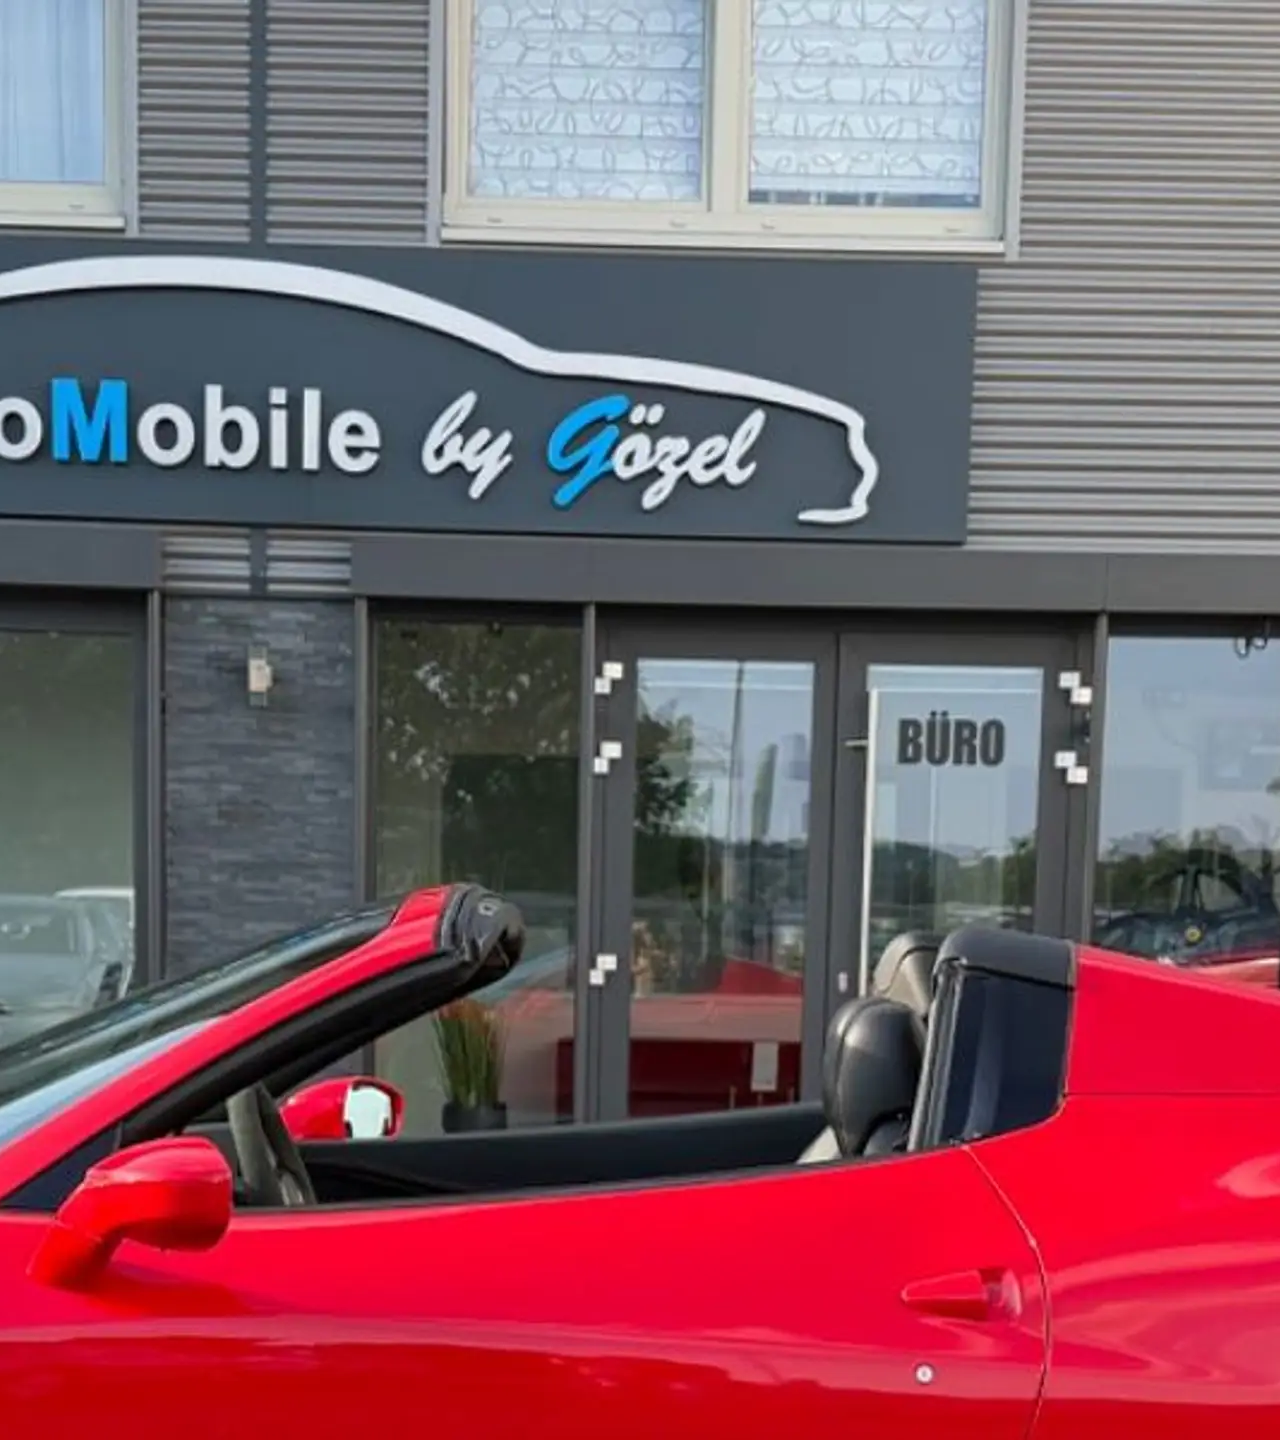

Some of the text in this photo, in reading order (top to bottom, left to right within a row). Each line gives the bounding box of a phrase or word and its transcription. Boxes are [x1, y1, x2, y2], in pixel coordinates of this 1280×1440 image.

[421, 389, 513, 499] by
[546, 394, 767, 510] Gözel
[897, 710, 1006, 768] BÜRO
